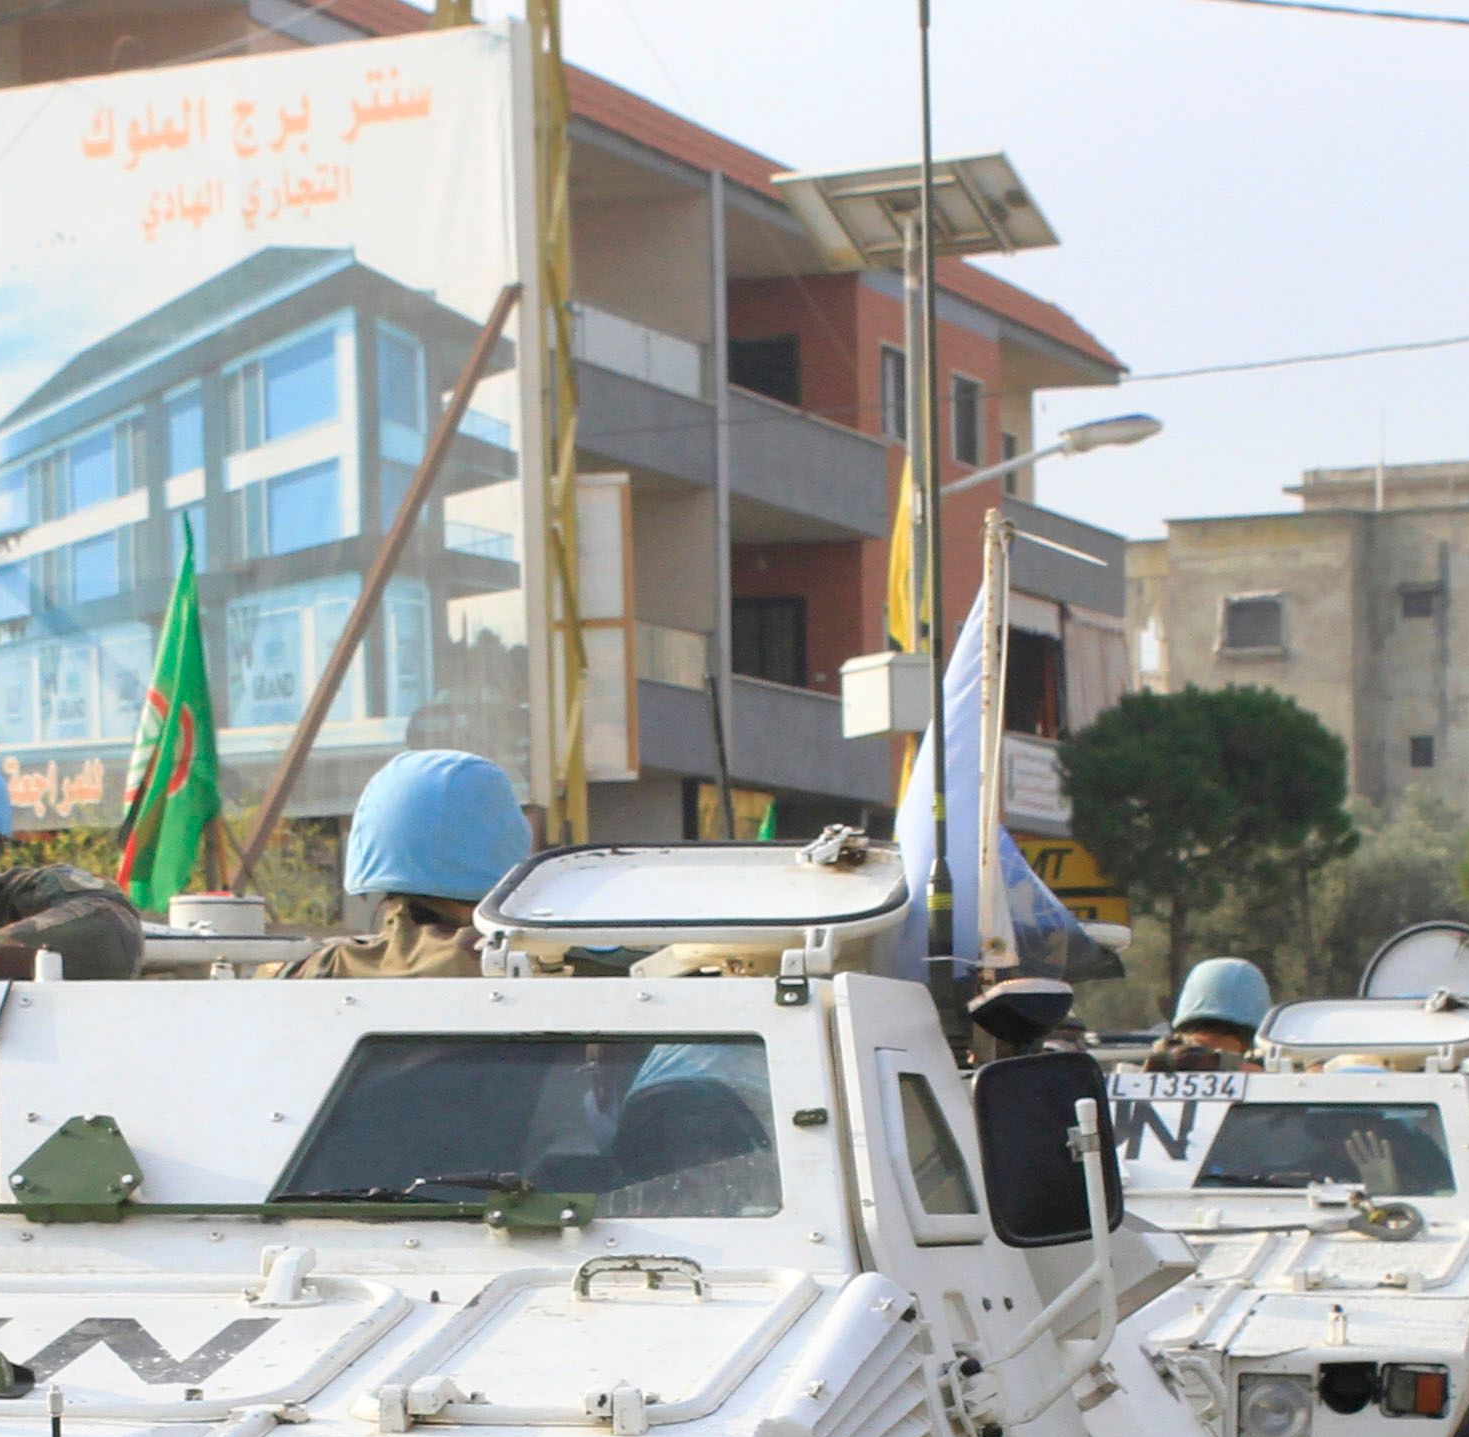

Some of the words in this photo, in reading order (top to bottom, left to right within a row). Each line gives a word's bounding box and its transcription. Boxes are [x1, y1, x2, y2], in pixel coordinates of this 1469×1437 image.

[82, 94, 208, 172] الملوك
[233, 93, 312, 159] برج
[341, 66, 432, 146] سنتر
[241, 163, 353, 232] التجاري
